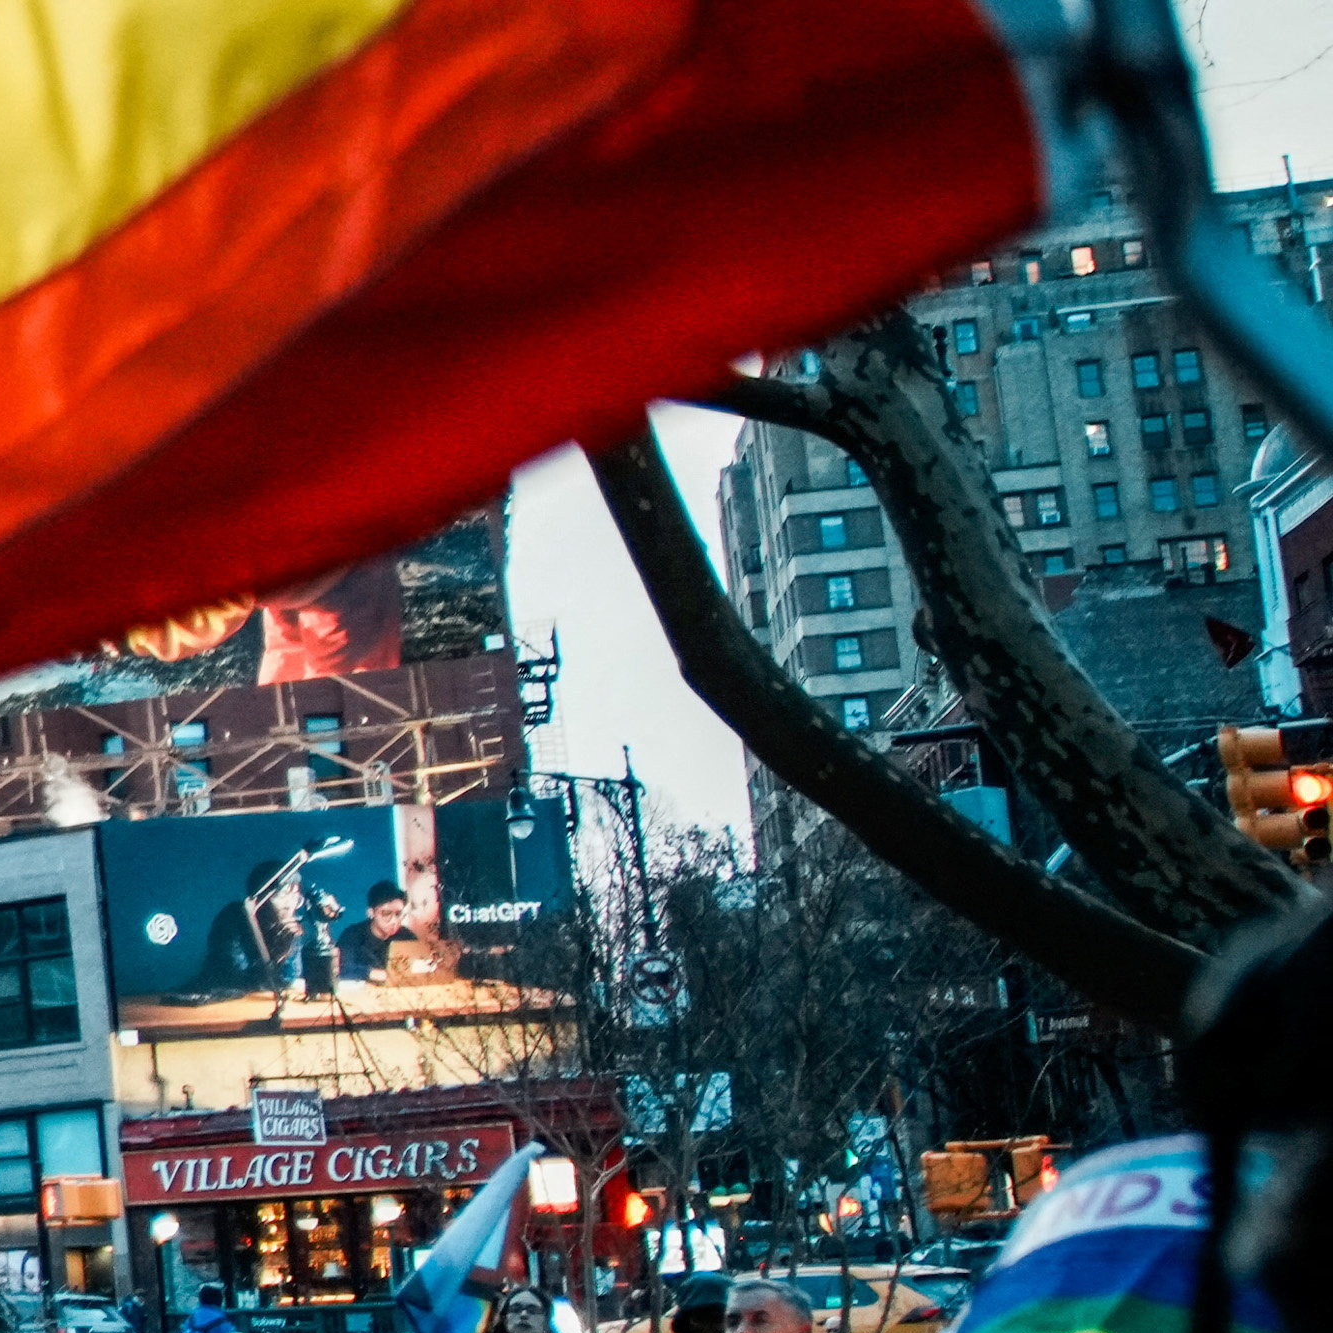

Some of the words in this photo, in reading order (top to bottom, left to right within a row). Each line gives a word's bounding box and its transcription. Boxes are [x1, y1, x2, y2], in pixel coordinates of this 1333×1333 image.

[259, 1098, 322, 1117] VILLAGE
[262, 1116, 320, 1140] CIGARS
[151, 1149, 315, 1193] VILLAGE
[326, 1137, 481, 1183] CIGARS
